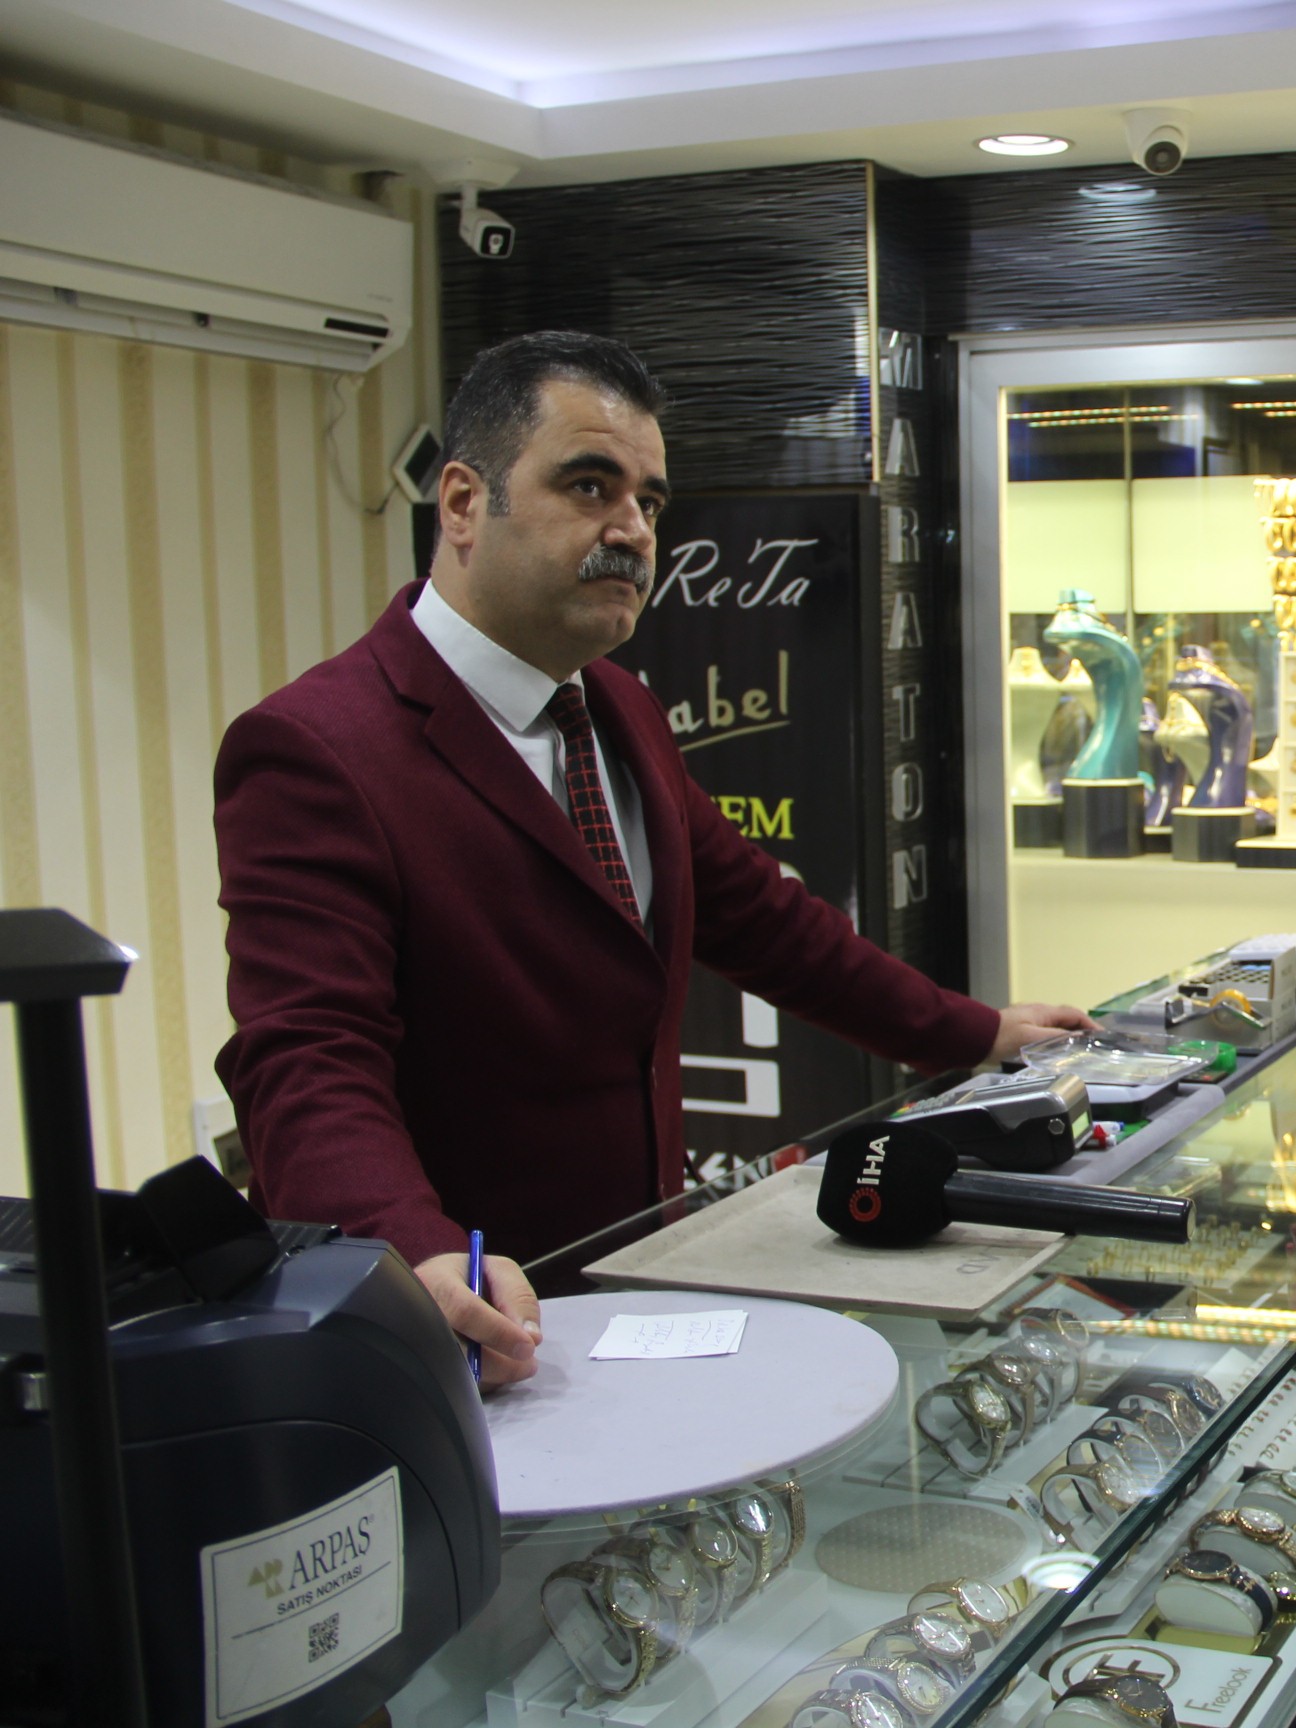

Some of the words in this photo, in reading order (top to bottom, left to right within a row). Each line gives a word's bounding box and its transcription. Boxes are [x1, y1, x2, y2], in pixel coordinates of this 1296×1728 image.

[879, 327, 927, 909] MARATON
[639, 650, 789, 733] abel
[710, 796, 795, 840] EM
[1184, 1667, 1253, 1713] Freelook
